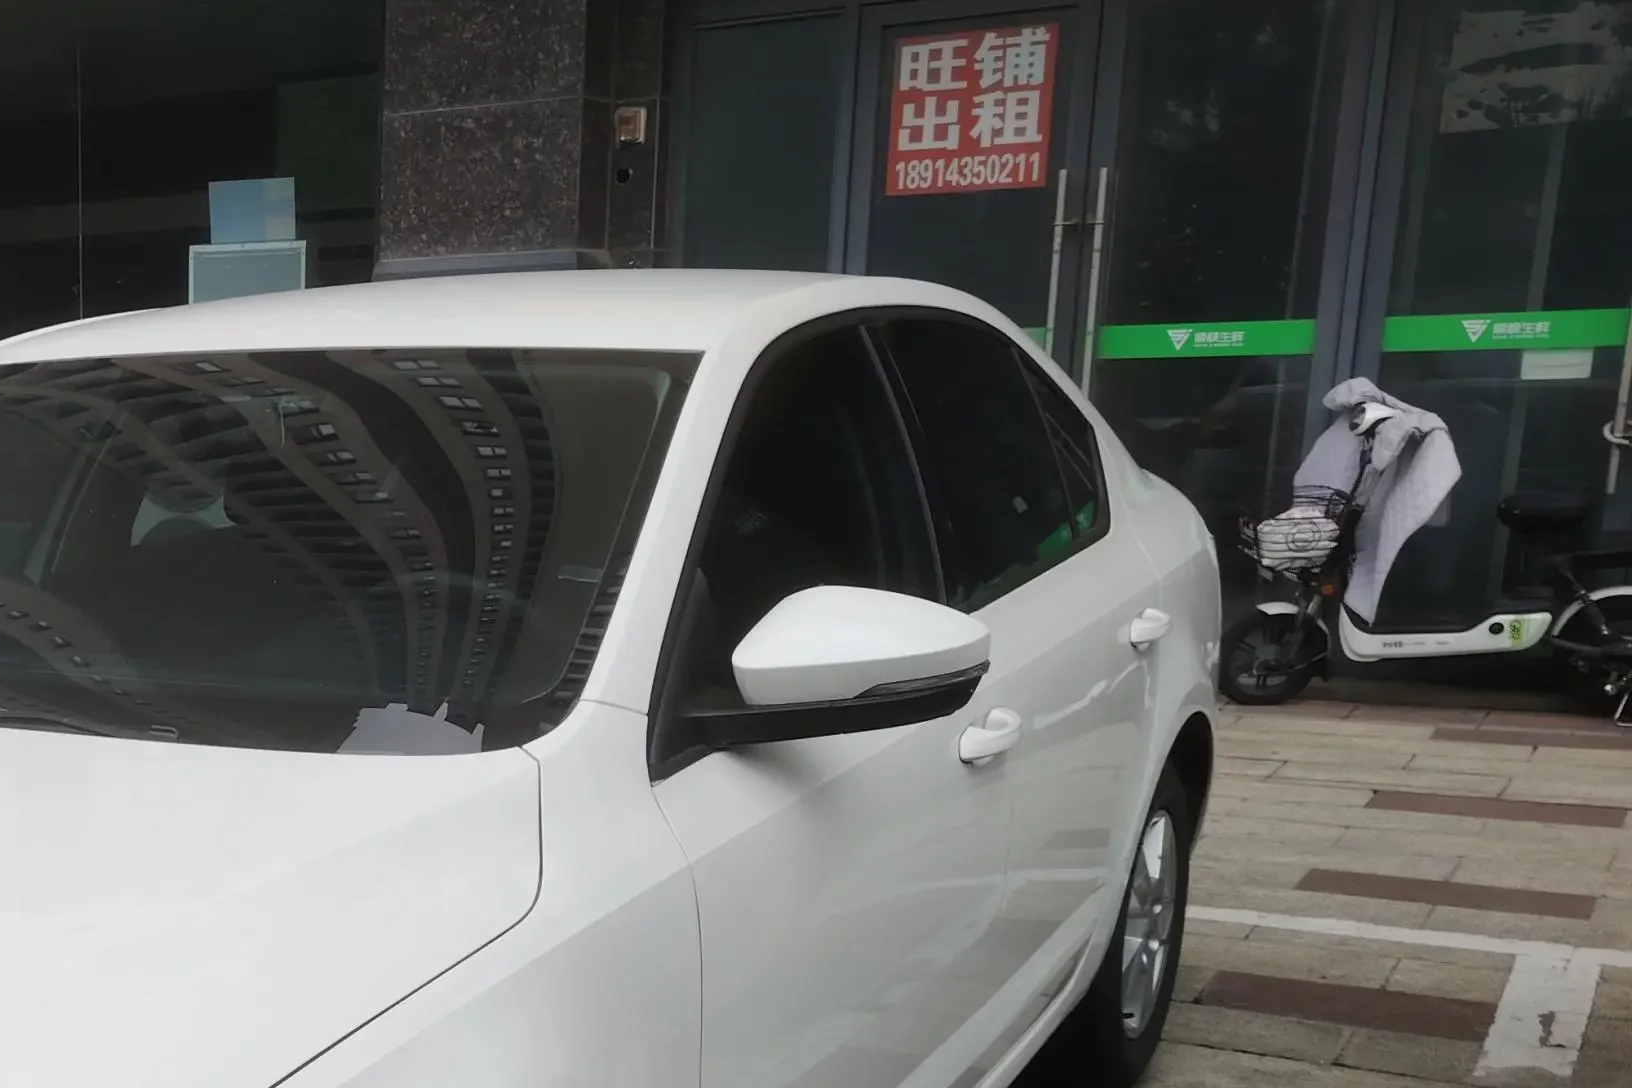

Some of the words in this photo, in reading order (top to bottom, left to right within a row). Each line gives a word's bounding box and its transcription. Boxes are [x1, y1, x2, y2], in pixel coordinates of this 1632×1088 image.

[899, 26, 1051, 92] 旺铺
[897, 90, 1043, 151] 出租
[895, 151, 1041, 190] 18914350211
